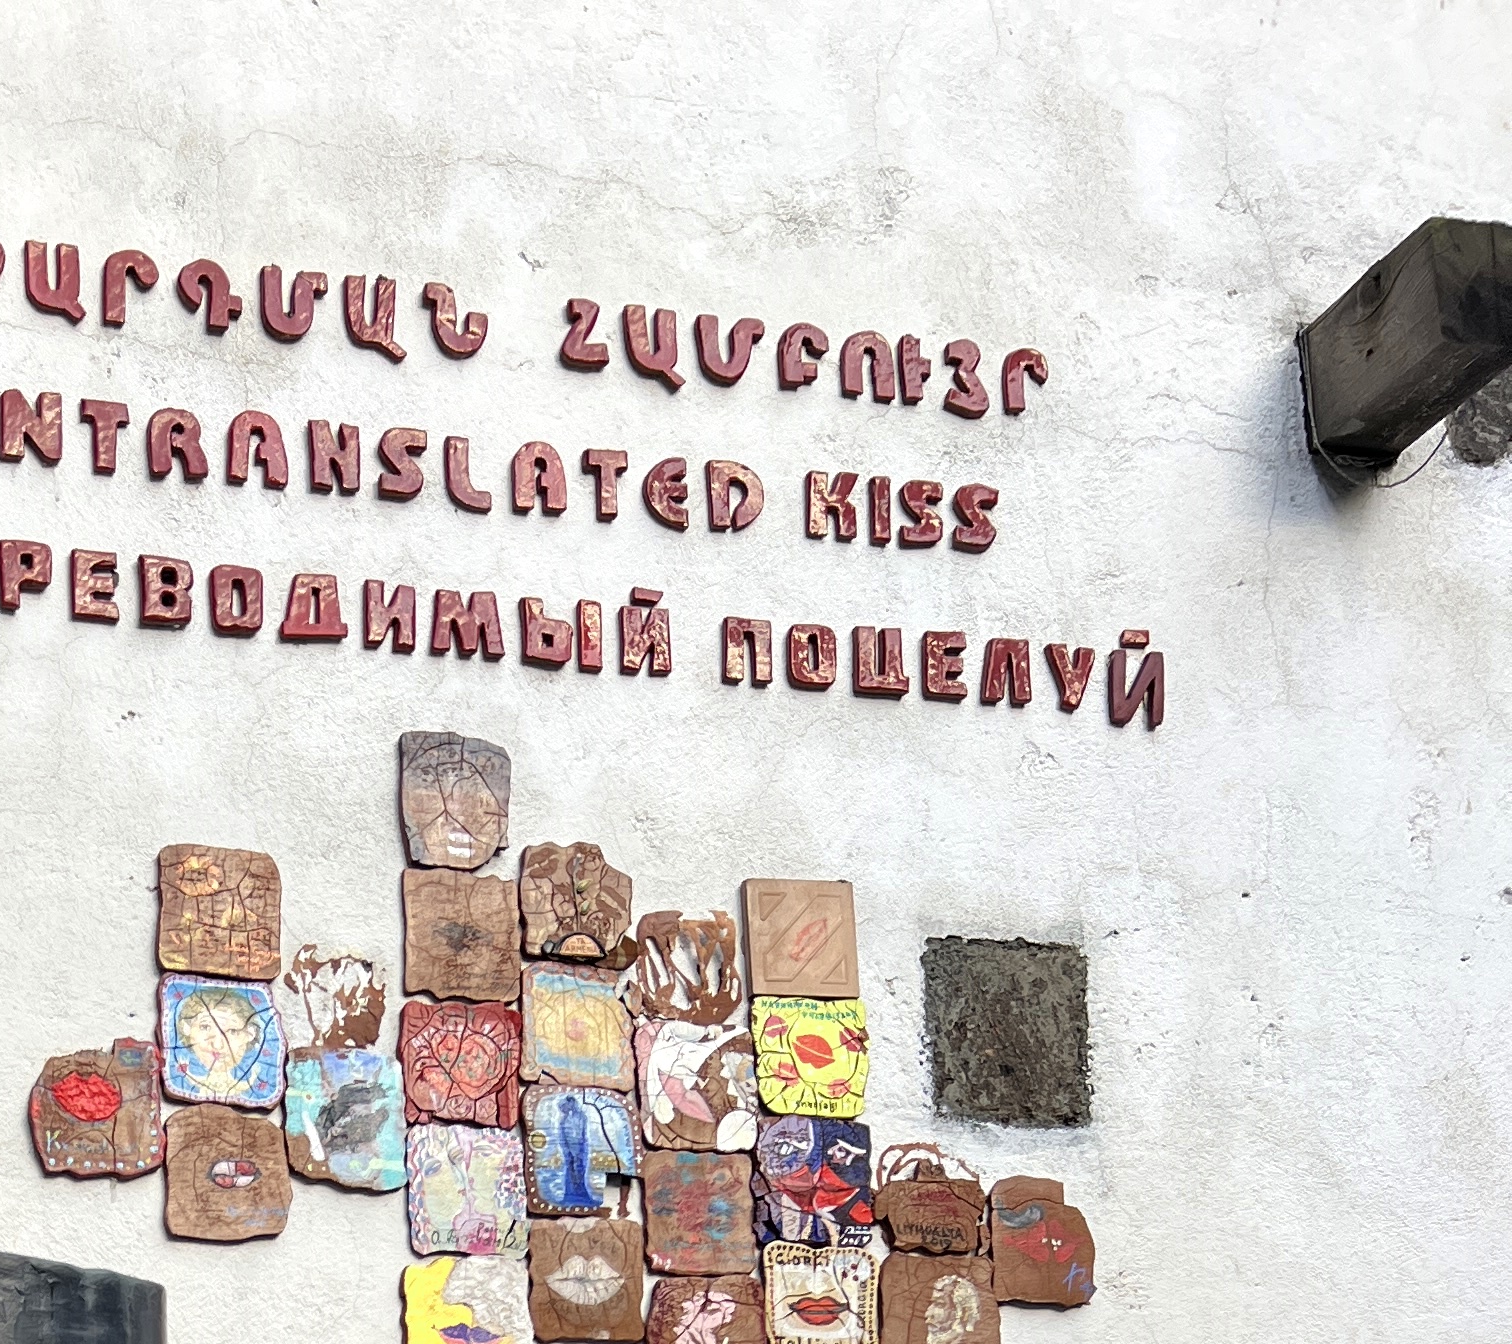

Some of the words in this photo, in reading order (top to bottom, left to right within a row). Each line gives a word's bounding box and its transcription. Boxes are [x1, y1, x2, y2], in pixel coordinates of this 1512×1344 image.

[560, 298, 1048, 419] ՀԱՄԲՈՒՅՐ
[804, 471, 999, 554] KISS
[721, 616, 1164, 730] ПОЦЕЛУЙ
